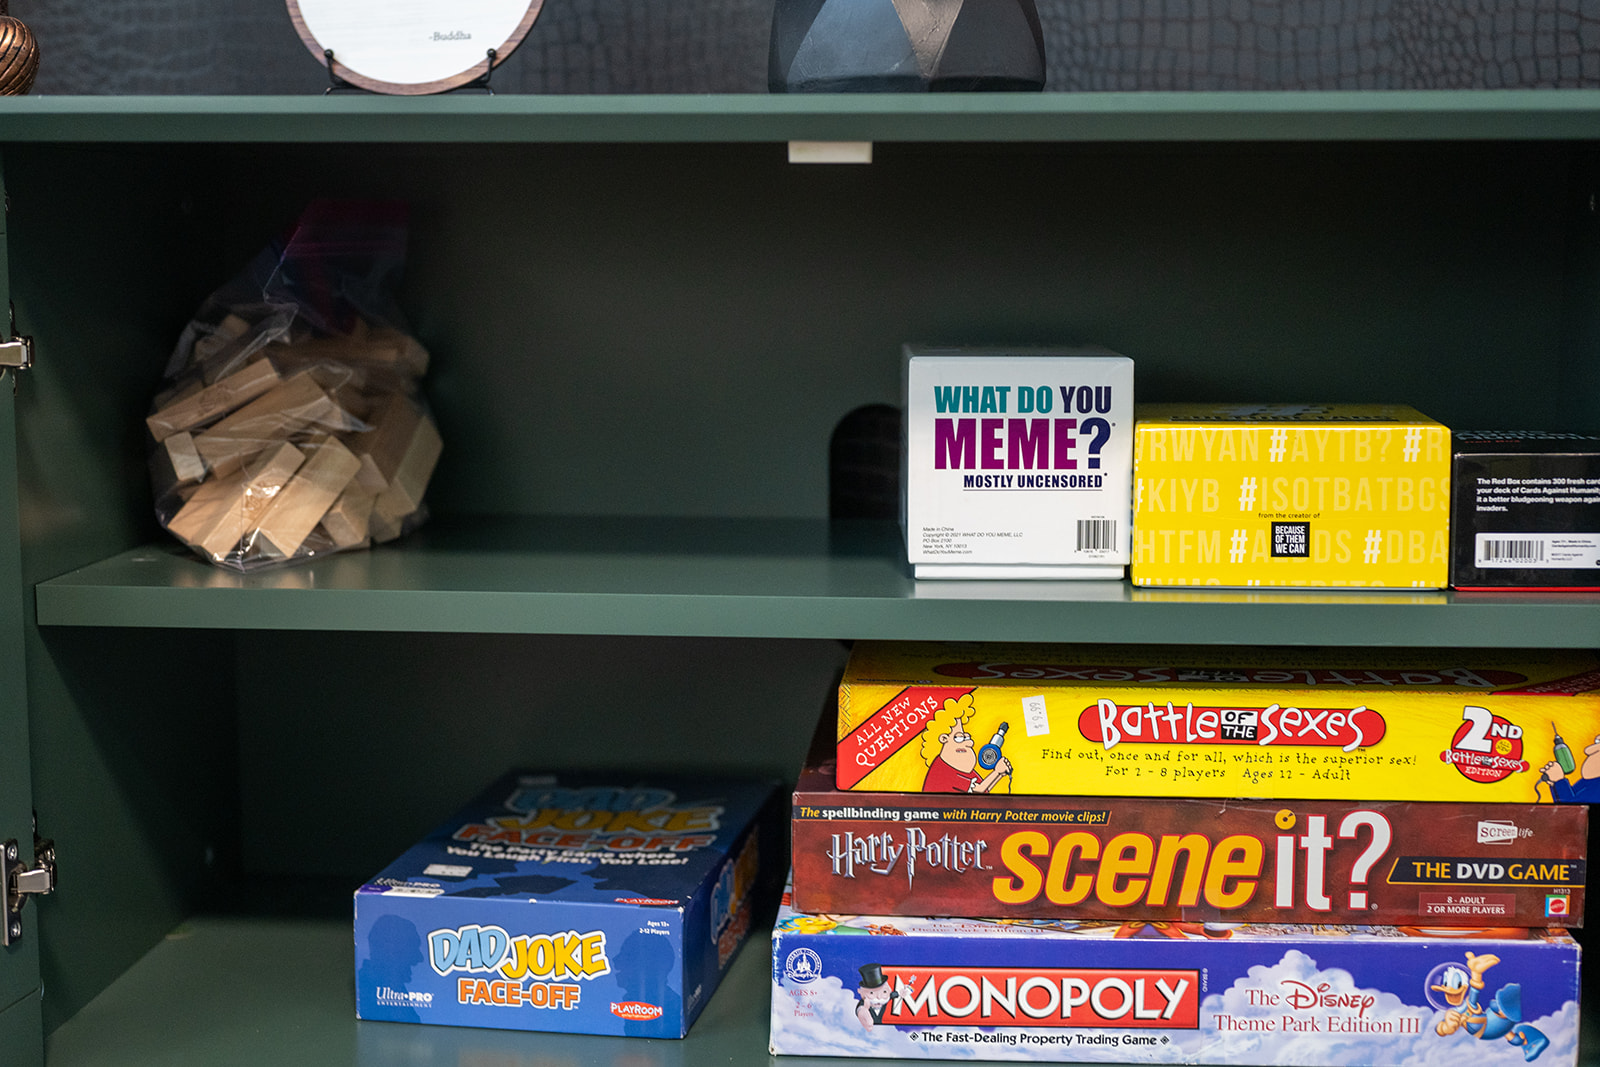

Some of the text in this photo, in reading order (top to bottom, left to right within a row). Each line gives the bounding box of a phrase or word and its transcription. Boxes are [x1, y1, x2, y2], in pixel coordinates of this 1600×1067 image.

[933, 385, 1112, 413] WHAT DO YOU
[934, 417, 1111, 470] MEME?
[1137, 430, 1259, 462] RWYAN
[963, 475, 1013, 488] MOSTLY
[1543, 487, 1569, 495] Against
[1511, 496, 1554, 504] bludgeoning
[1275, 525, 1305, 534] BECAUSE
[1275, 534, 1305, 543] OF THEM
[1275, 543, 1305, 553] WE CAN
[856, 697, 911, 746] ALL NEW
[856, 696, 938, 766] QUESTIONS
[1098, 699, 1367, 752] Battle OF THE Sexes
[1041, 749, 1417, 768] Find out, once and for all, which is the superior sex!
[1445, 749, 1481, 765] Battle
[1491, 756, 1525, 773] Sexes
[1105, 766, 1129, 776] For
[1135, 767, 1142, 776] 2
[1160, 768, 1167, 777] 8
[1173, 767, 1226, 781] players
[1242, 768, 1274, 784] Ages
[1280, 770, 1293, 779] 12
[1312, 769, 1351, 780] Adult
[1465, 766, 1502, 778] EDITION
[486, 806, 723, 832] JOKE
[800, 807, 1106, 824] The spellbinding game with Harry Potter movie clips!
[453, 824, 716, 851] FACE-OFF
[469, 843, 503, 852] The
[826, 827, 987, 890] Harry Potter
[992, 809, 1393, 912] scene it?
[1412, 862, 1570, 881] THE DVD GAME
[651, 928, 670, 936] Players
[429, 925, 609, 980] DAD JOKE
[459, 978, 580, 1009] FACE-OFF
[892, 974, 1190, 1020] MONOPOLY
[1245, 980, 1375, 1018] The Disney
[611, 1003, 663, 1016] PLAYROOM
[1213, 1015, 1421, 1033] Theme Park Edition III
[921, 1031, 1158, 1047] The Fast-Dealing Property Trading Game
